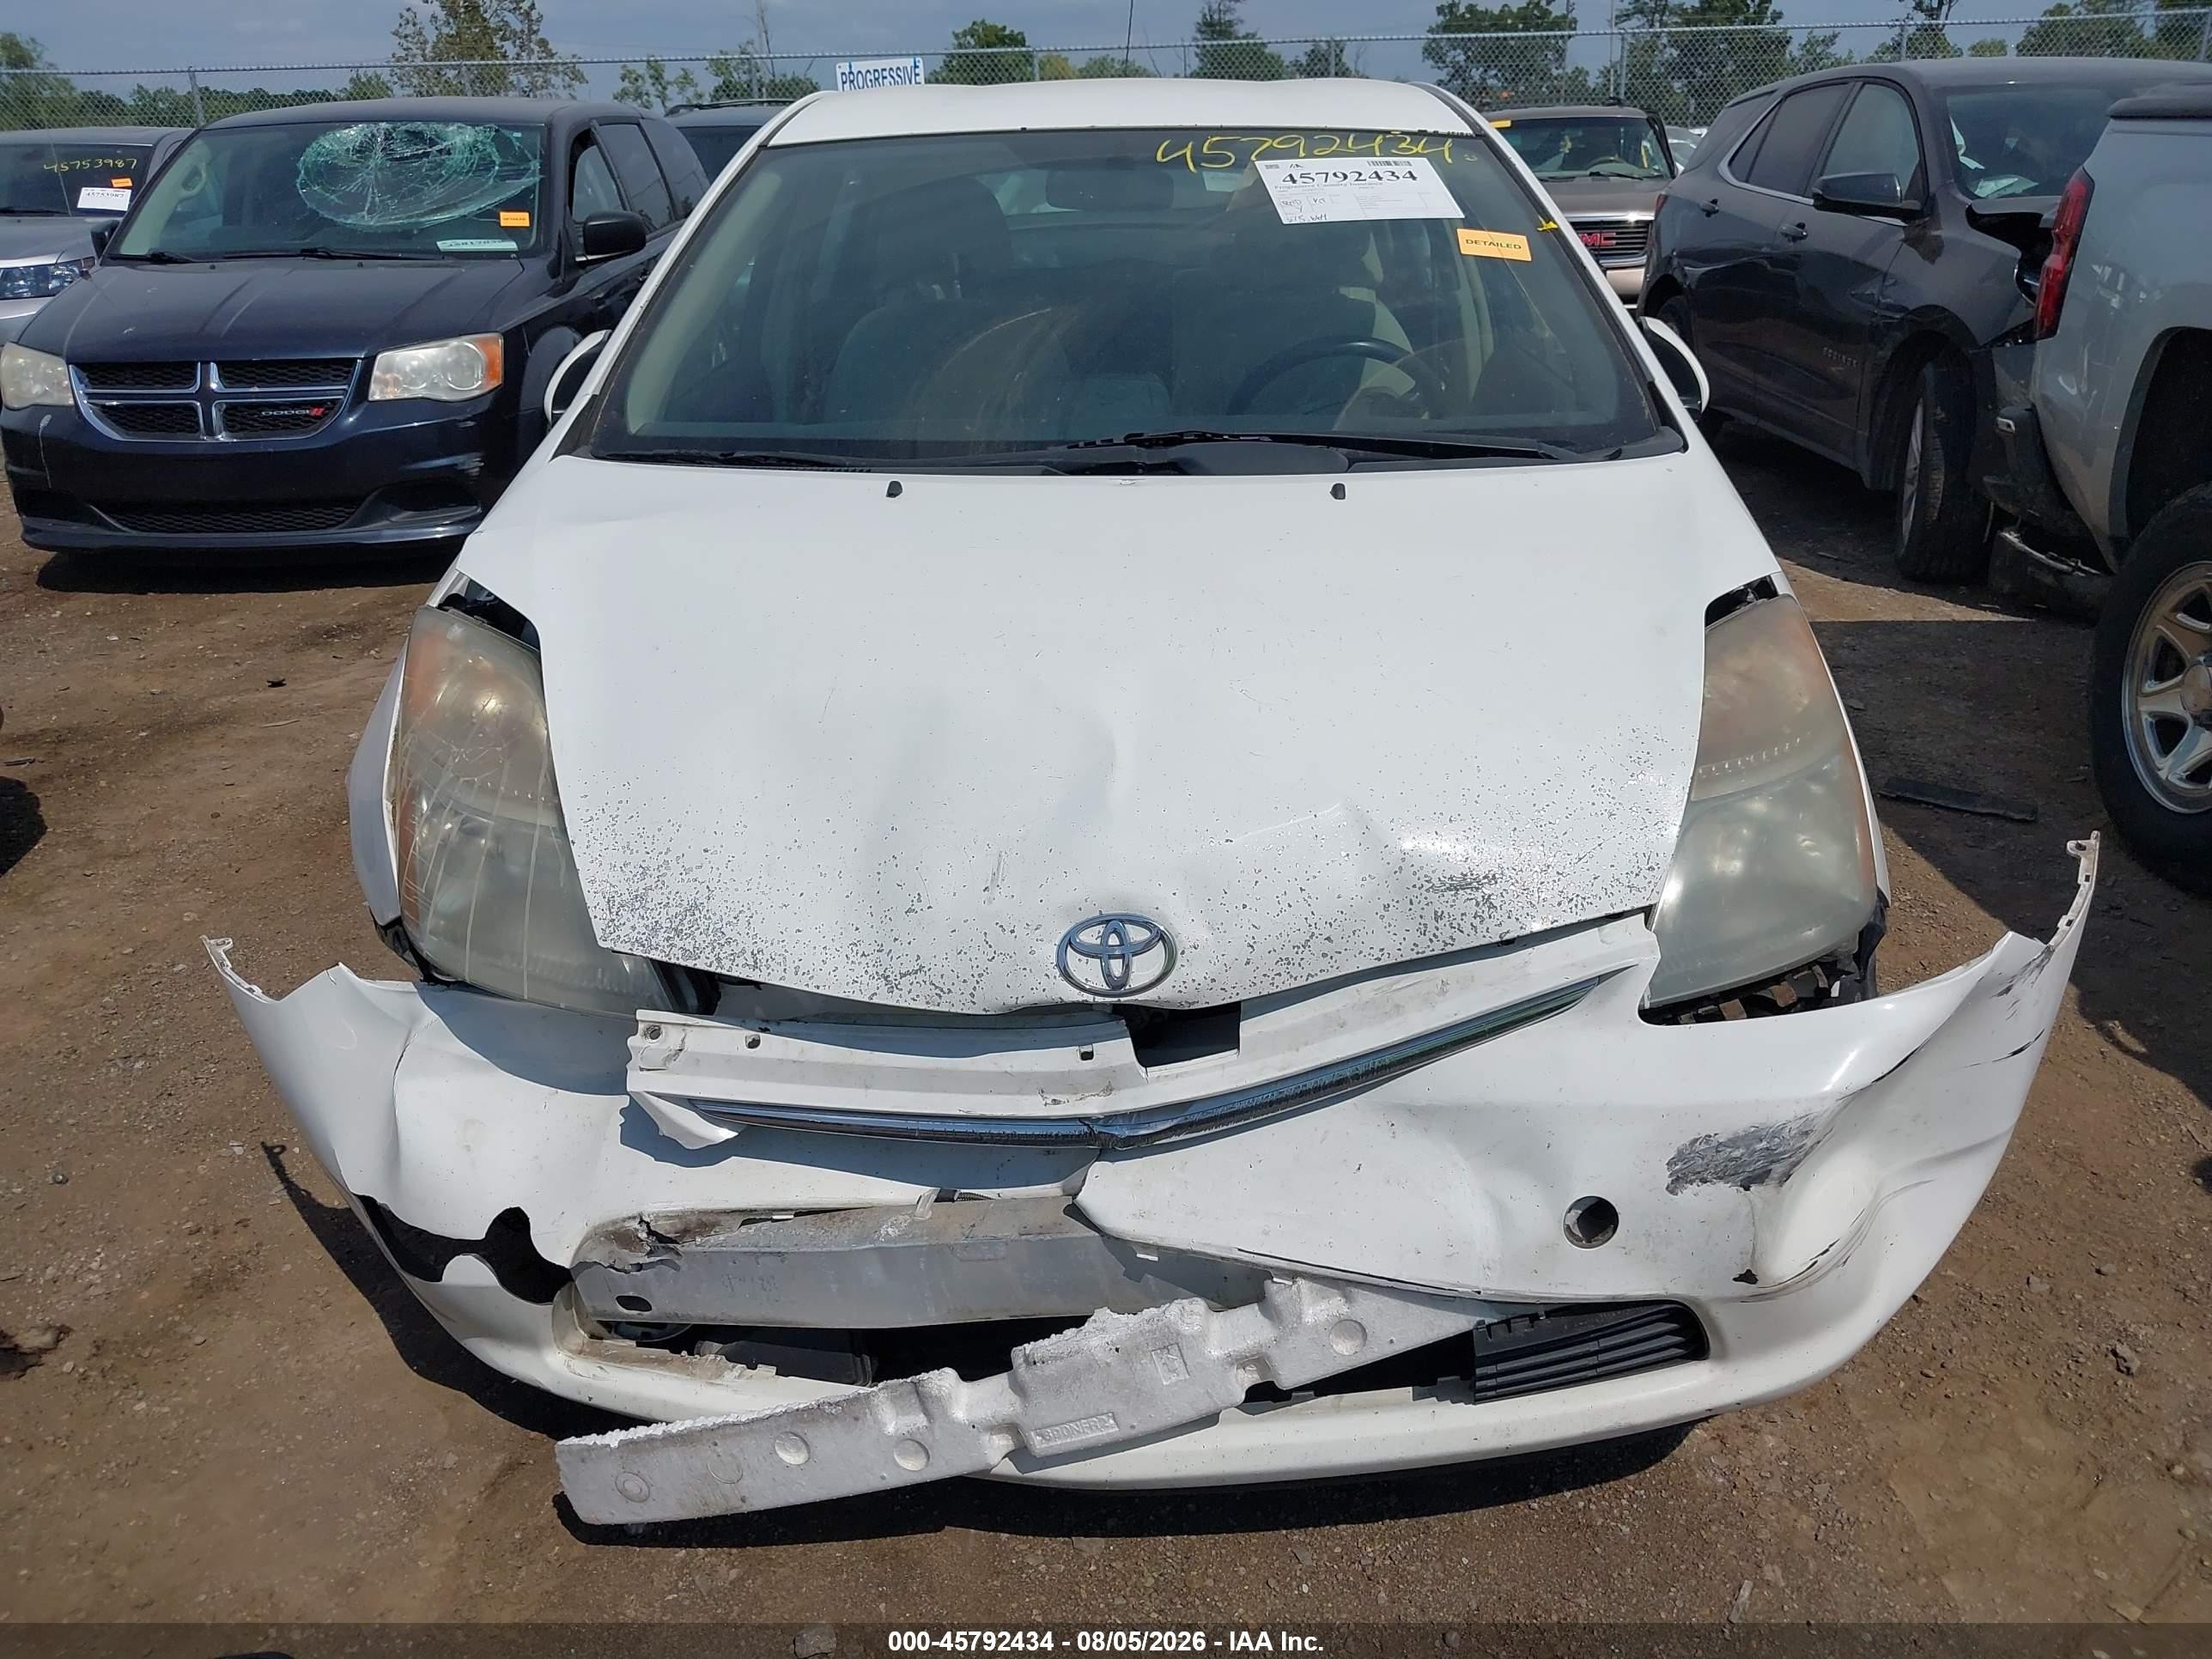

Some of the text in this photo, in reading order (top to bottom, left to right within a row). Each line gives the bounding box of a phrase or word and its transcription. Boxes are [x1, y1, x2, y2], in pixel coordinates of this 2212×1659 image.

[841, 65, 921, 92] PROGRESSIVE
[1156, 134, 1453, 173] 45792434
[1282, 170, 1418, 185] 45792434
[1464, 239, 1522, 250] DETAILED
[1578, 232, 1617, 246] MC
